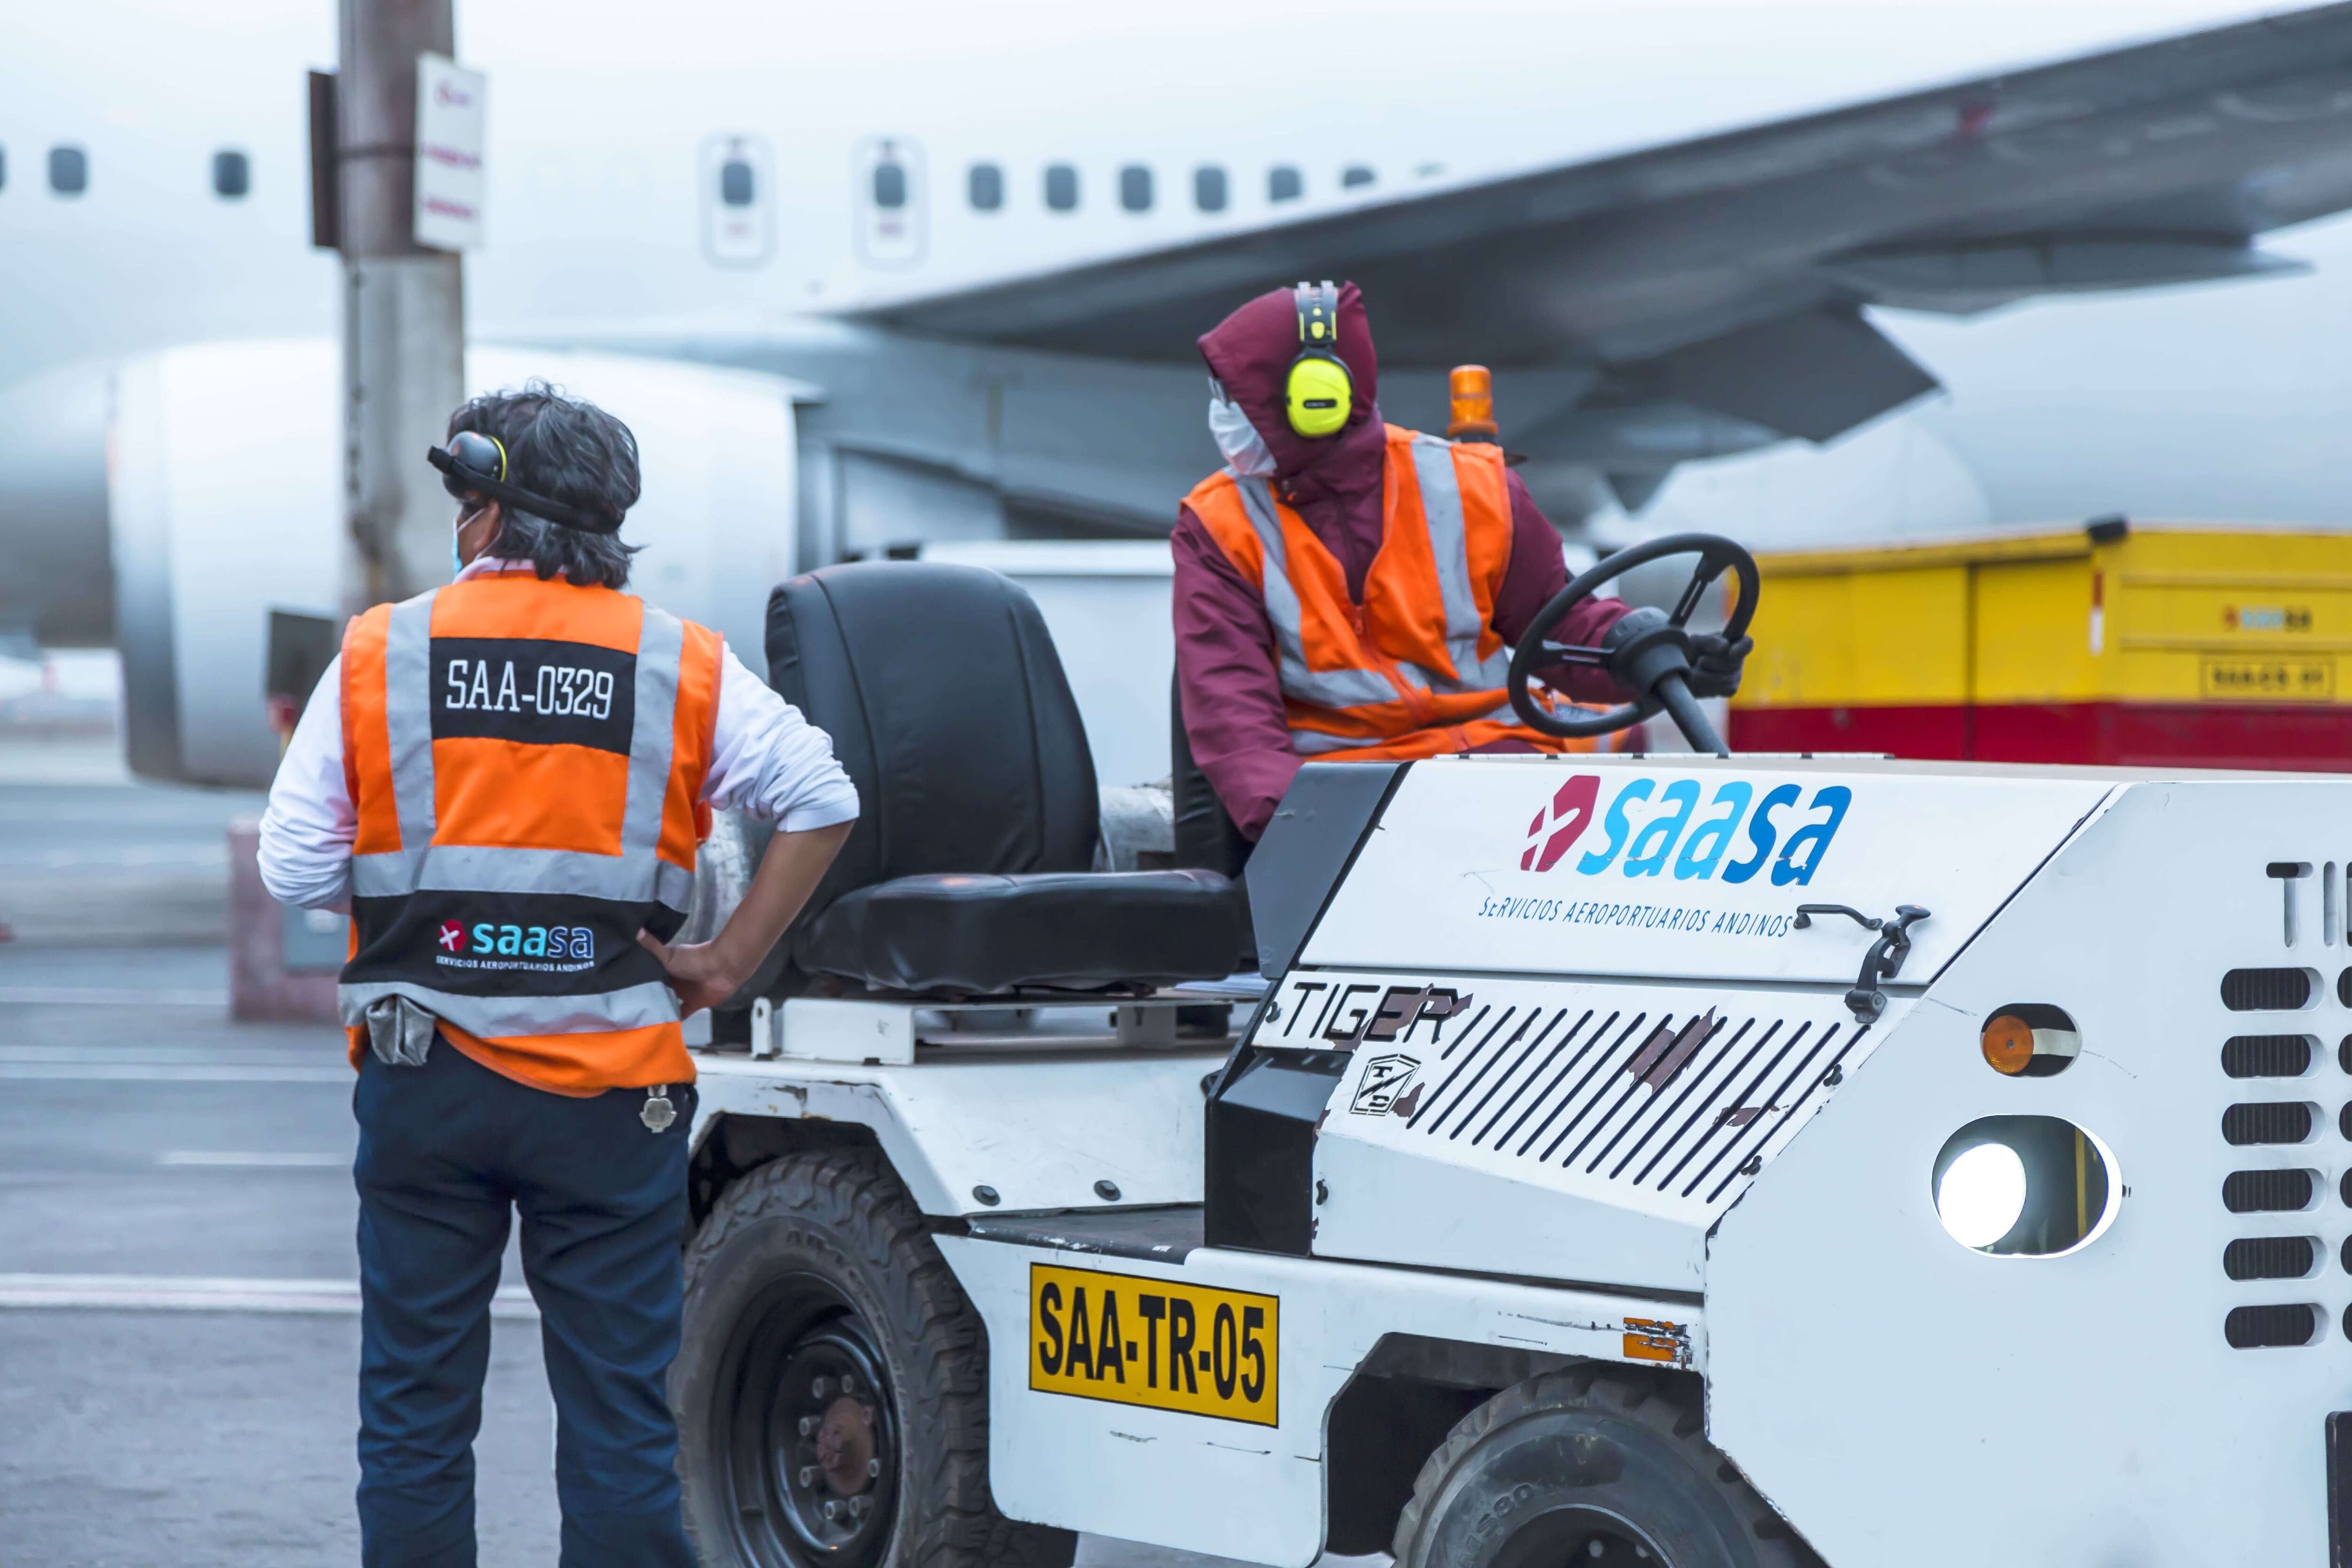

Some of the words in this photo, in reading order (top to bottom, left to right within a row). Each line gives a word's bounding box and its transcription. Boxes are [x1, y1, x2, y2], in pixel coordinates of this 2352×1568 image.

[446, 660, 613, 720] SAA-0329
[1576, 778, 1852, 886] saasa
[1478, 896, 1563, 922] SERVICIOS
[1562, 901, 1711, 932] AEROPORTUARIOS
[1711, 911, 1793, 938] ANDINOS
[2265, 860, 2352, 949] TI
[436, 955, 478, 969] SERVICIOS
[556, 961, 595, 972] ANDINOS
[472, 923, 595, 959] saasa
[1283, 981, 1458, 1045] TIGER
[1039, 1281, 1266, 1403] SAA-TR-05
